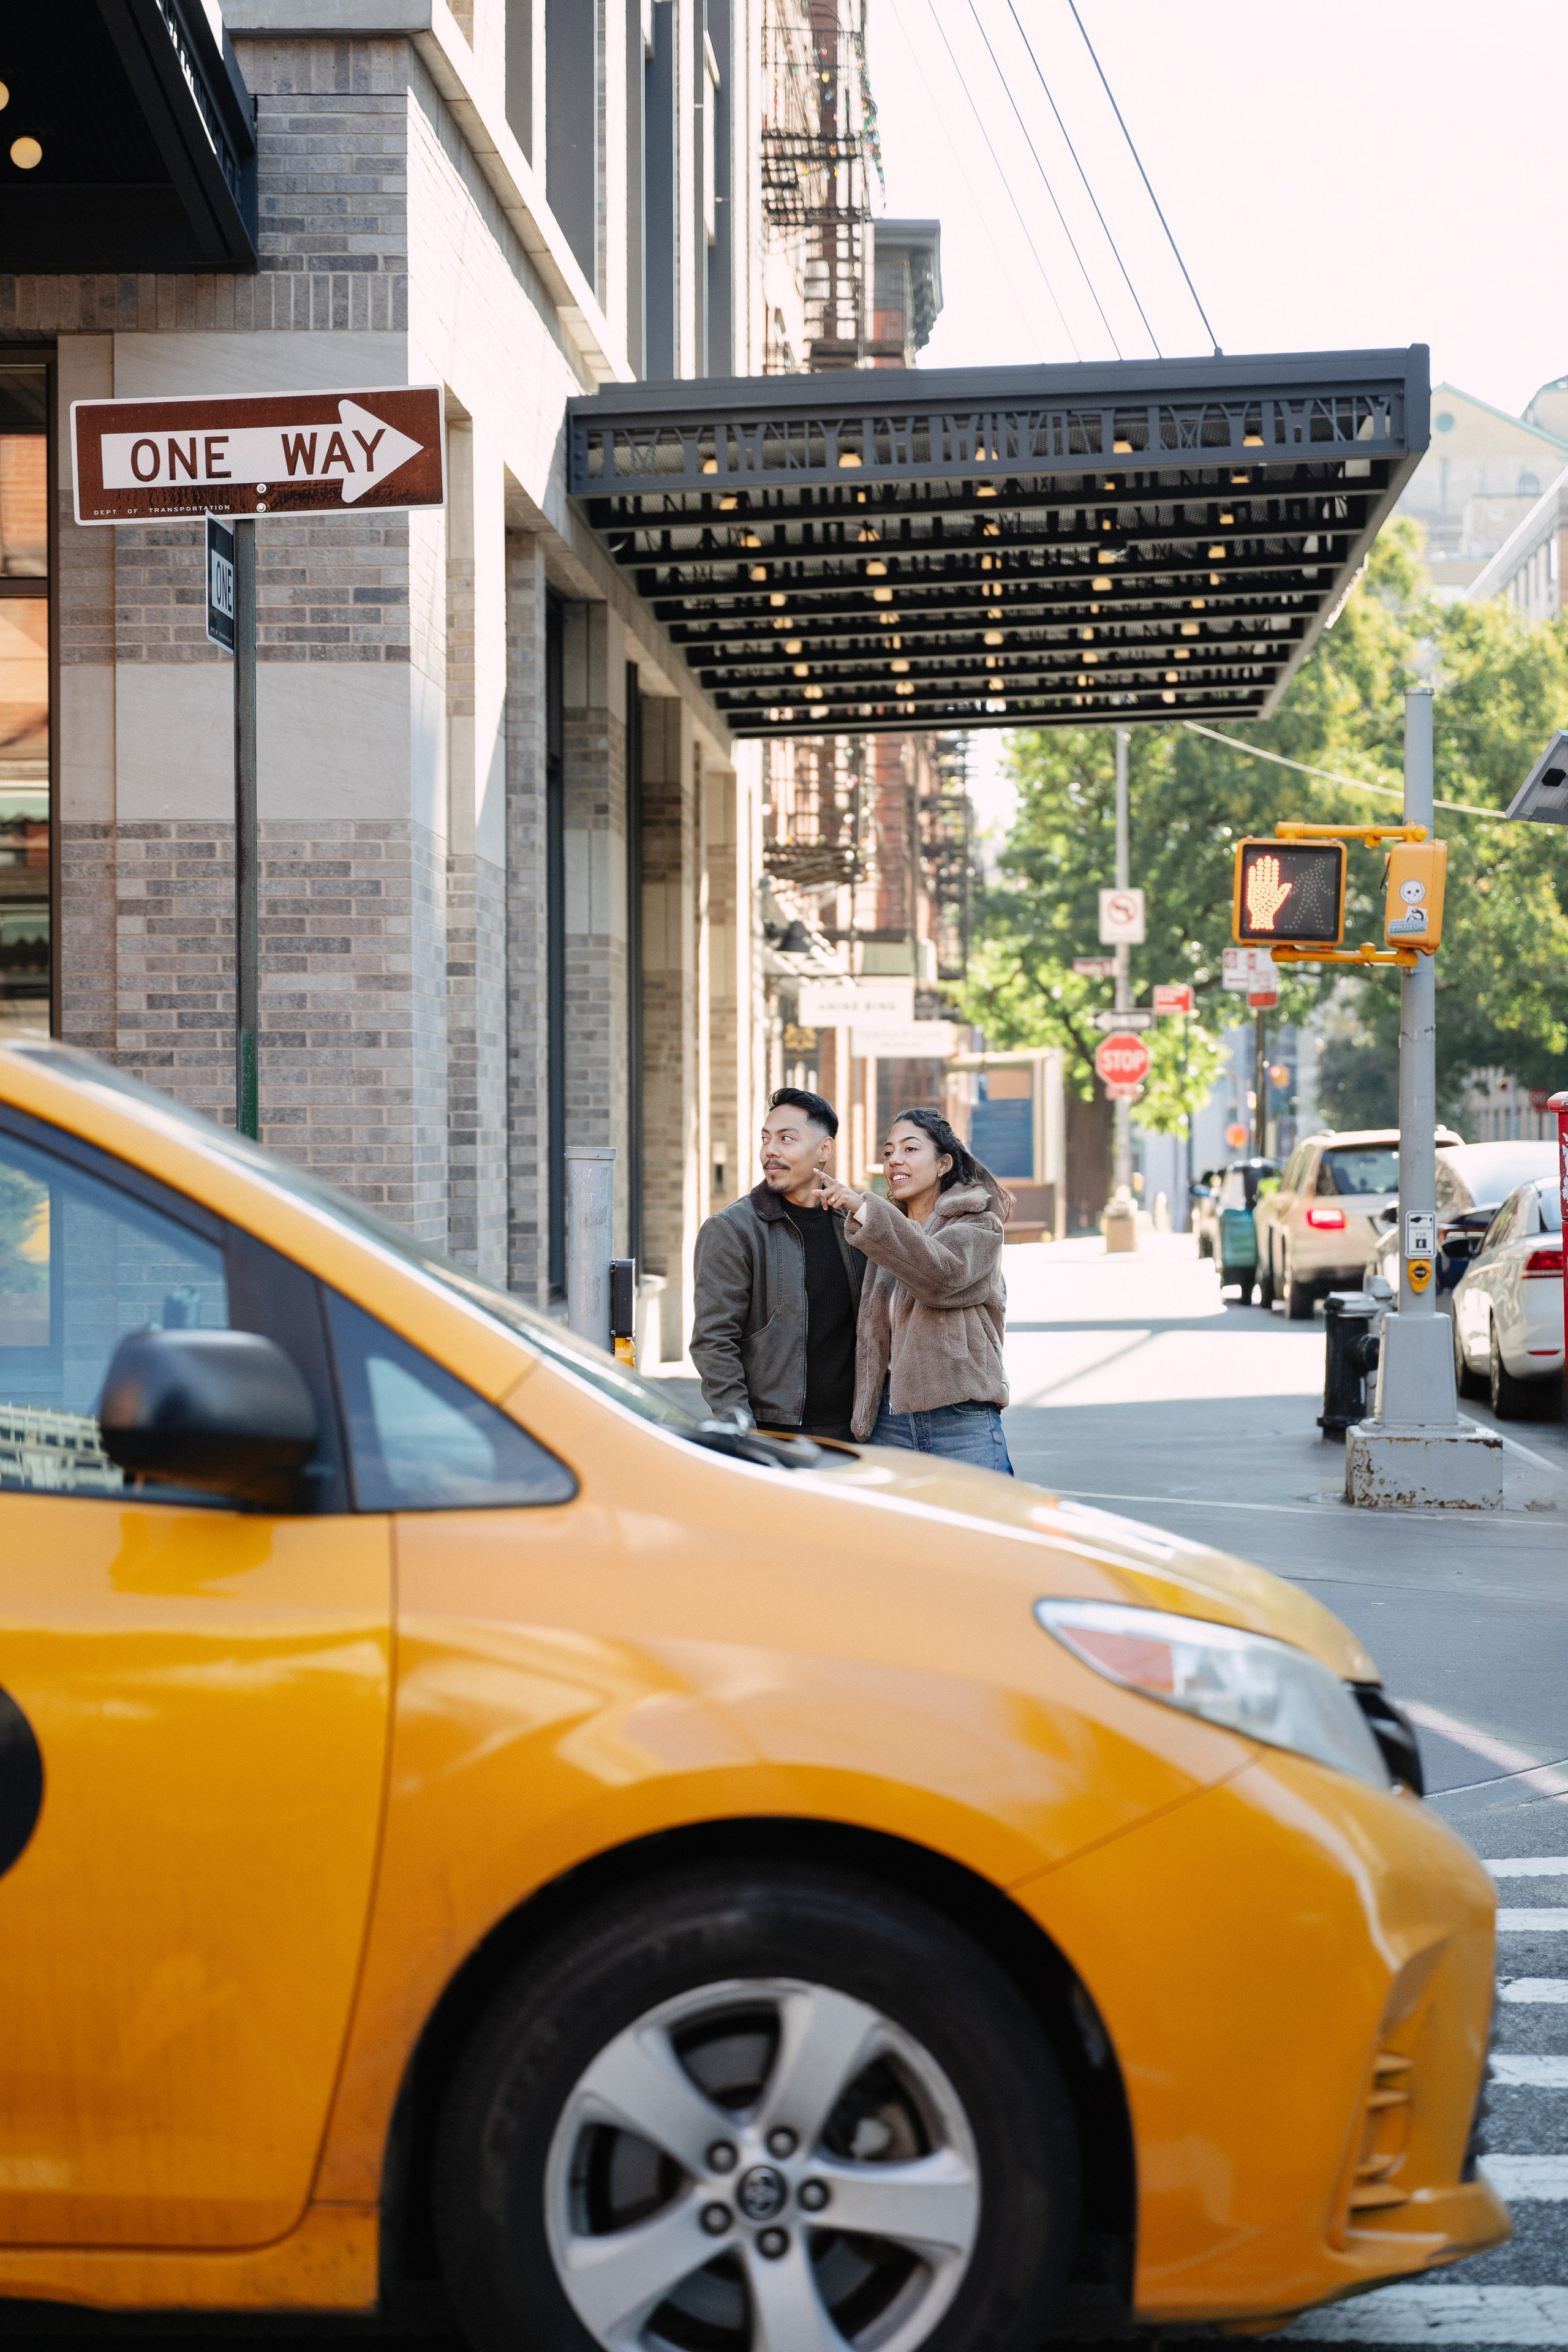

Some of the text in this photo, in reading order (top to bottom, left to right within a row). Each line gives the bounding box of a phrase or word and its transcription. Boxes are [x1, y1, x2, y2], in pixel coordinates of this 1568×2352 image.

[131, 429, 386, 482] ONE WAY
[149, 505, 230, 513] TRANSPORTATION
[216, 560, 232, 613] ONE
[1102, 1049, 1145, 1071] STOP
